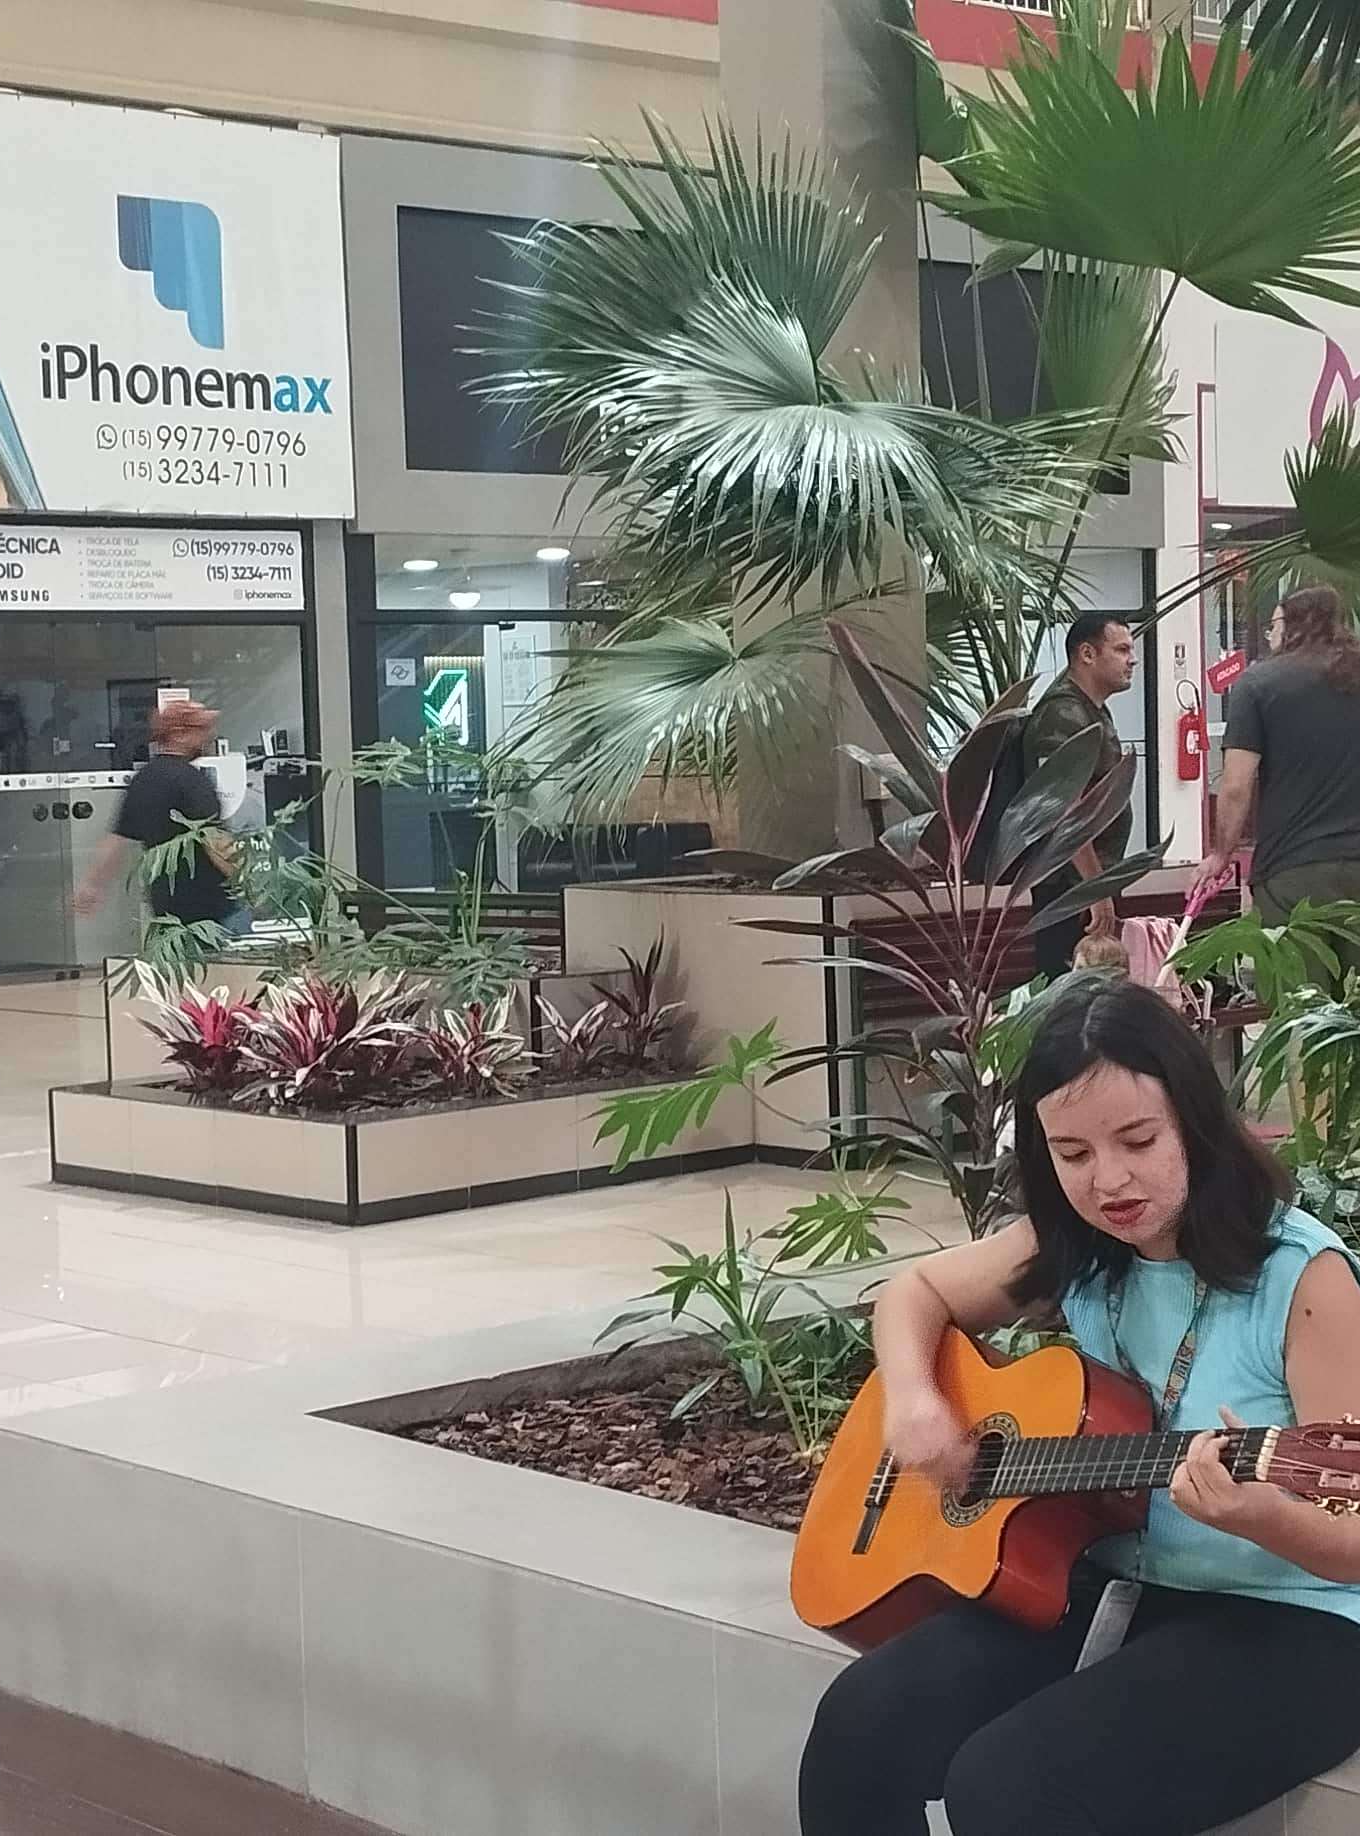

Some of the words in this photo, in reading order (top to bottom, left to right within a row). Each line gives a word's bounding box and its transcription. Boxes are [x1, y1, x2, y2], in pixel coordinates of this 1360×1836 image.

[40, 342, 333, 414] iPhonemax
[122, 429, 152, 449] (15)
[156, 425, 307, 457] 99779-0796
[123, 461, 152, 482] (15)
[157, 458, 288, 488] 3234-7111
[206, 564, 228, 582] (15)
[231, 566, 292, 580] 3234-7111
